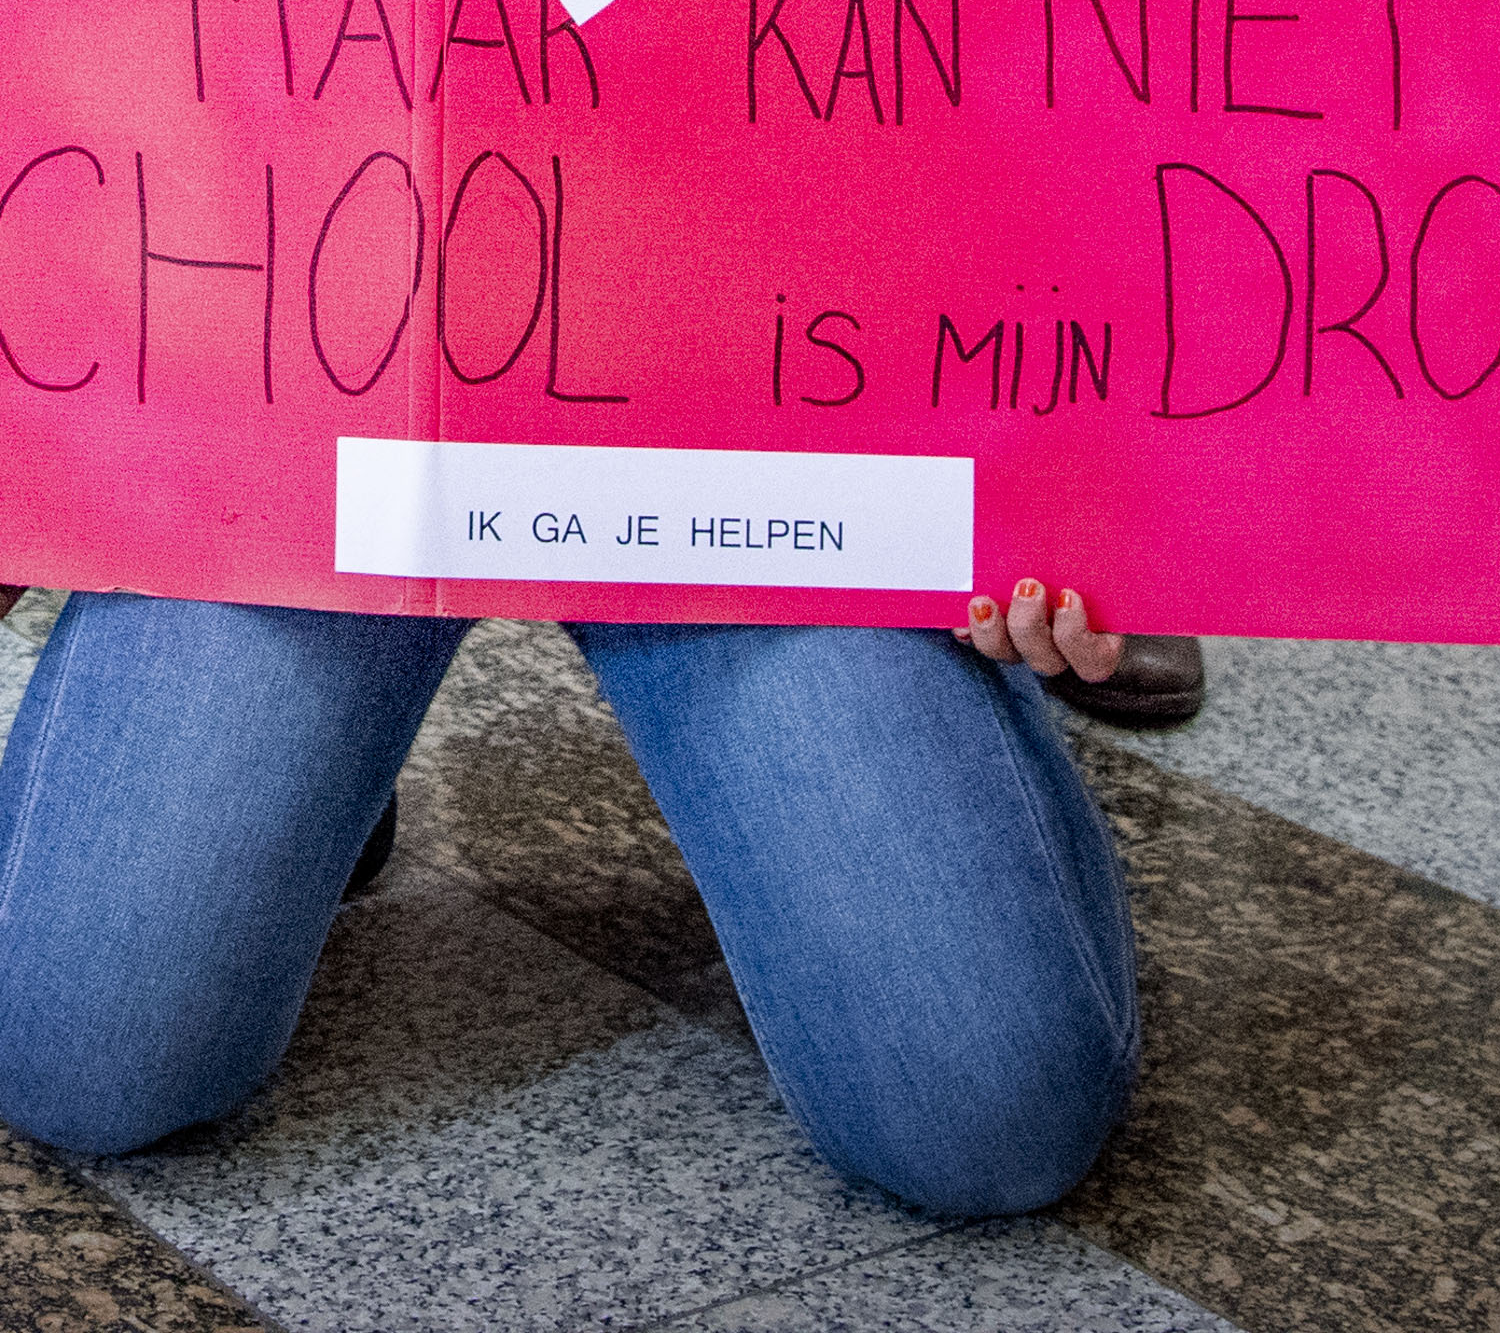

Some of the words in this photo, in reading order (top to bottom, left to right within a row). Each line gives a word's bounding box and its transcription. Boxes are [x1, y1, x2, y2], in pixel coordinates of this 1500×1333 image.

[468, 511, 502, 541] IK
[531, 512, 587, 544] GA
[615, 514, 660, 546] JE
[690, 517, 844, 552] HELPEN
